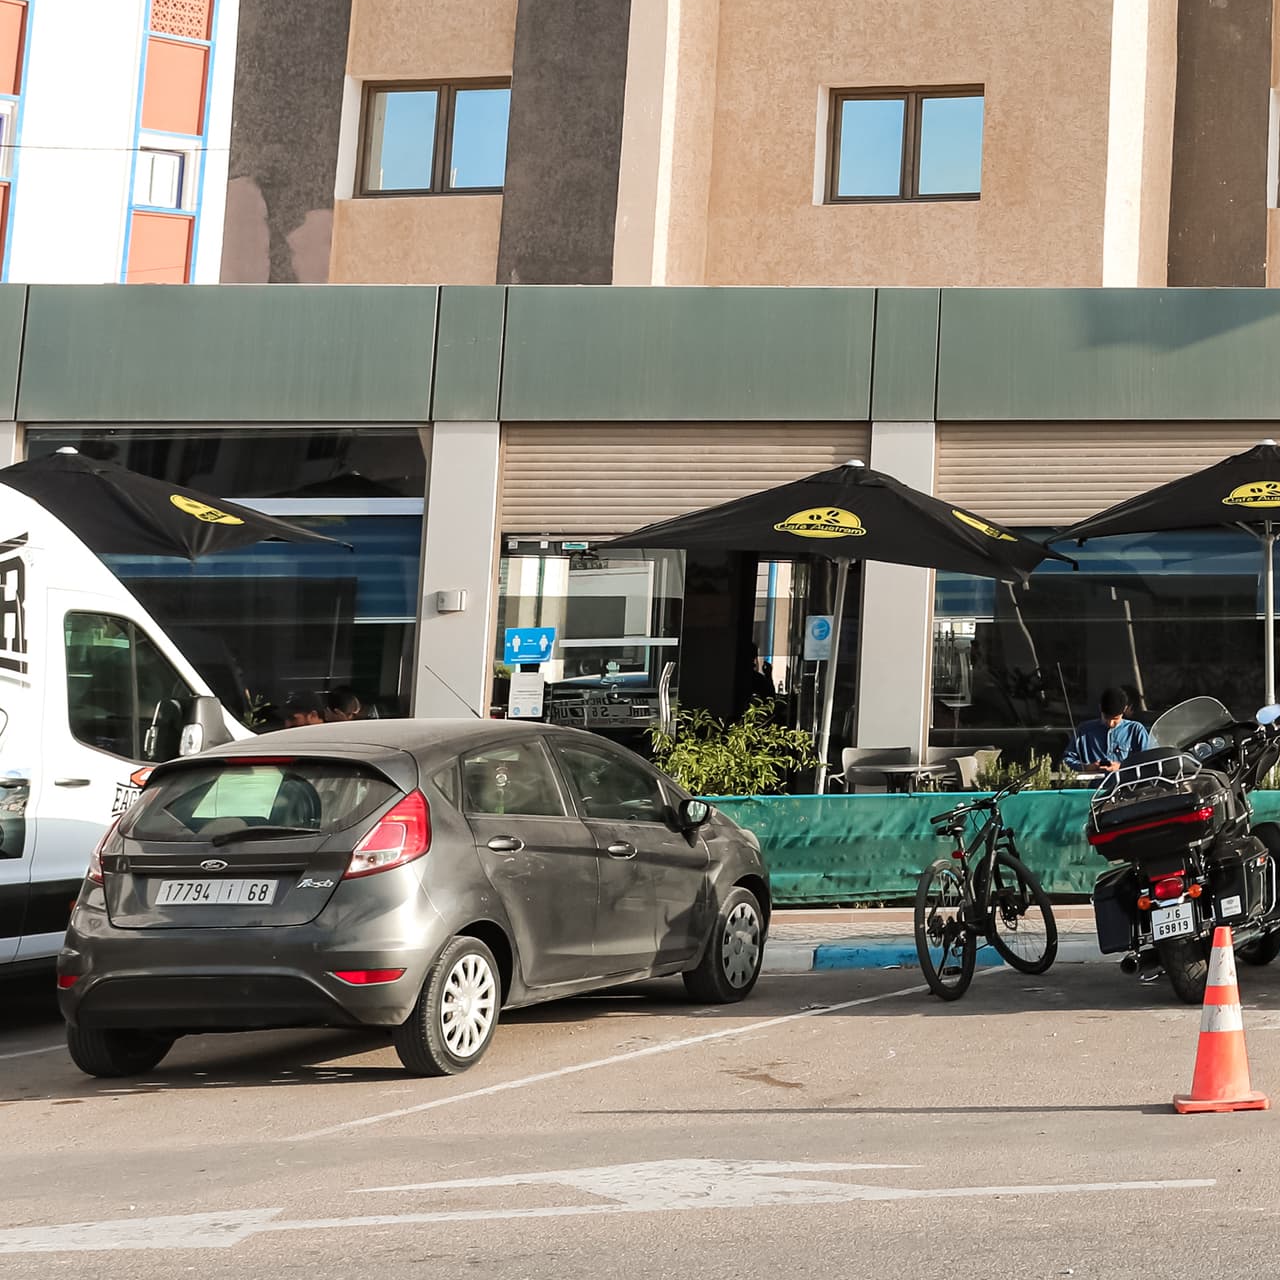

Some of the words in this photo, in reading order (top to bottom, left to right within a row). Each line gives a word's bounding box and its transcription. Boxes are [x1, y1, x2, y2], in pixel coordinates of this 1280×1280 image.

[112, 787, 143, 812] EAG
[165, 883, 211, 901] 17794
[247, 883, 269, 902] 68
[1175, 908, 1181, 919] 6
[1159, 920, 1188, 935] 69819
